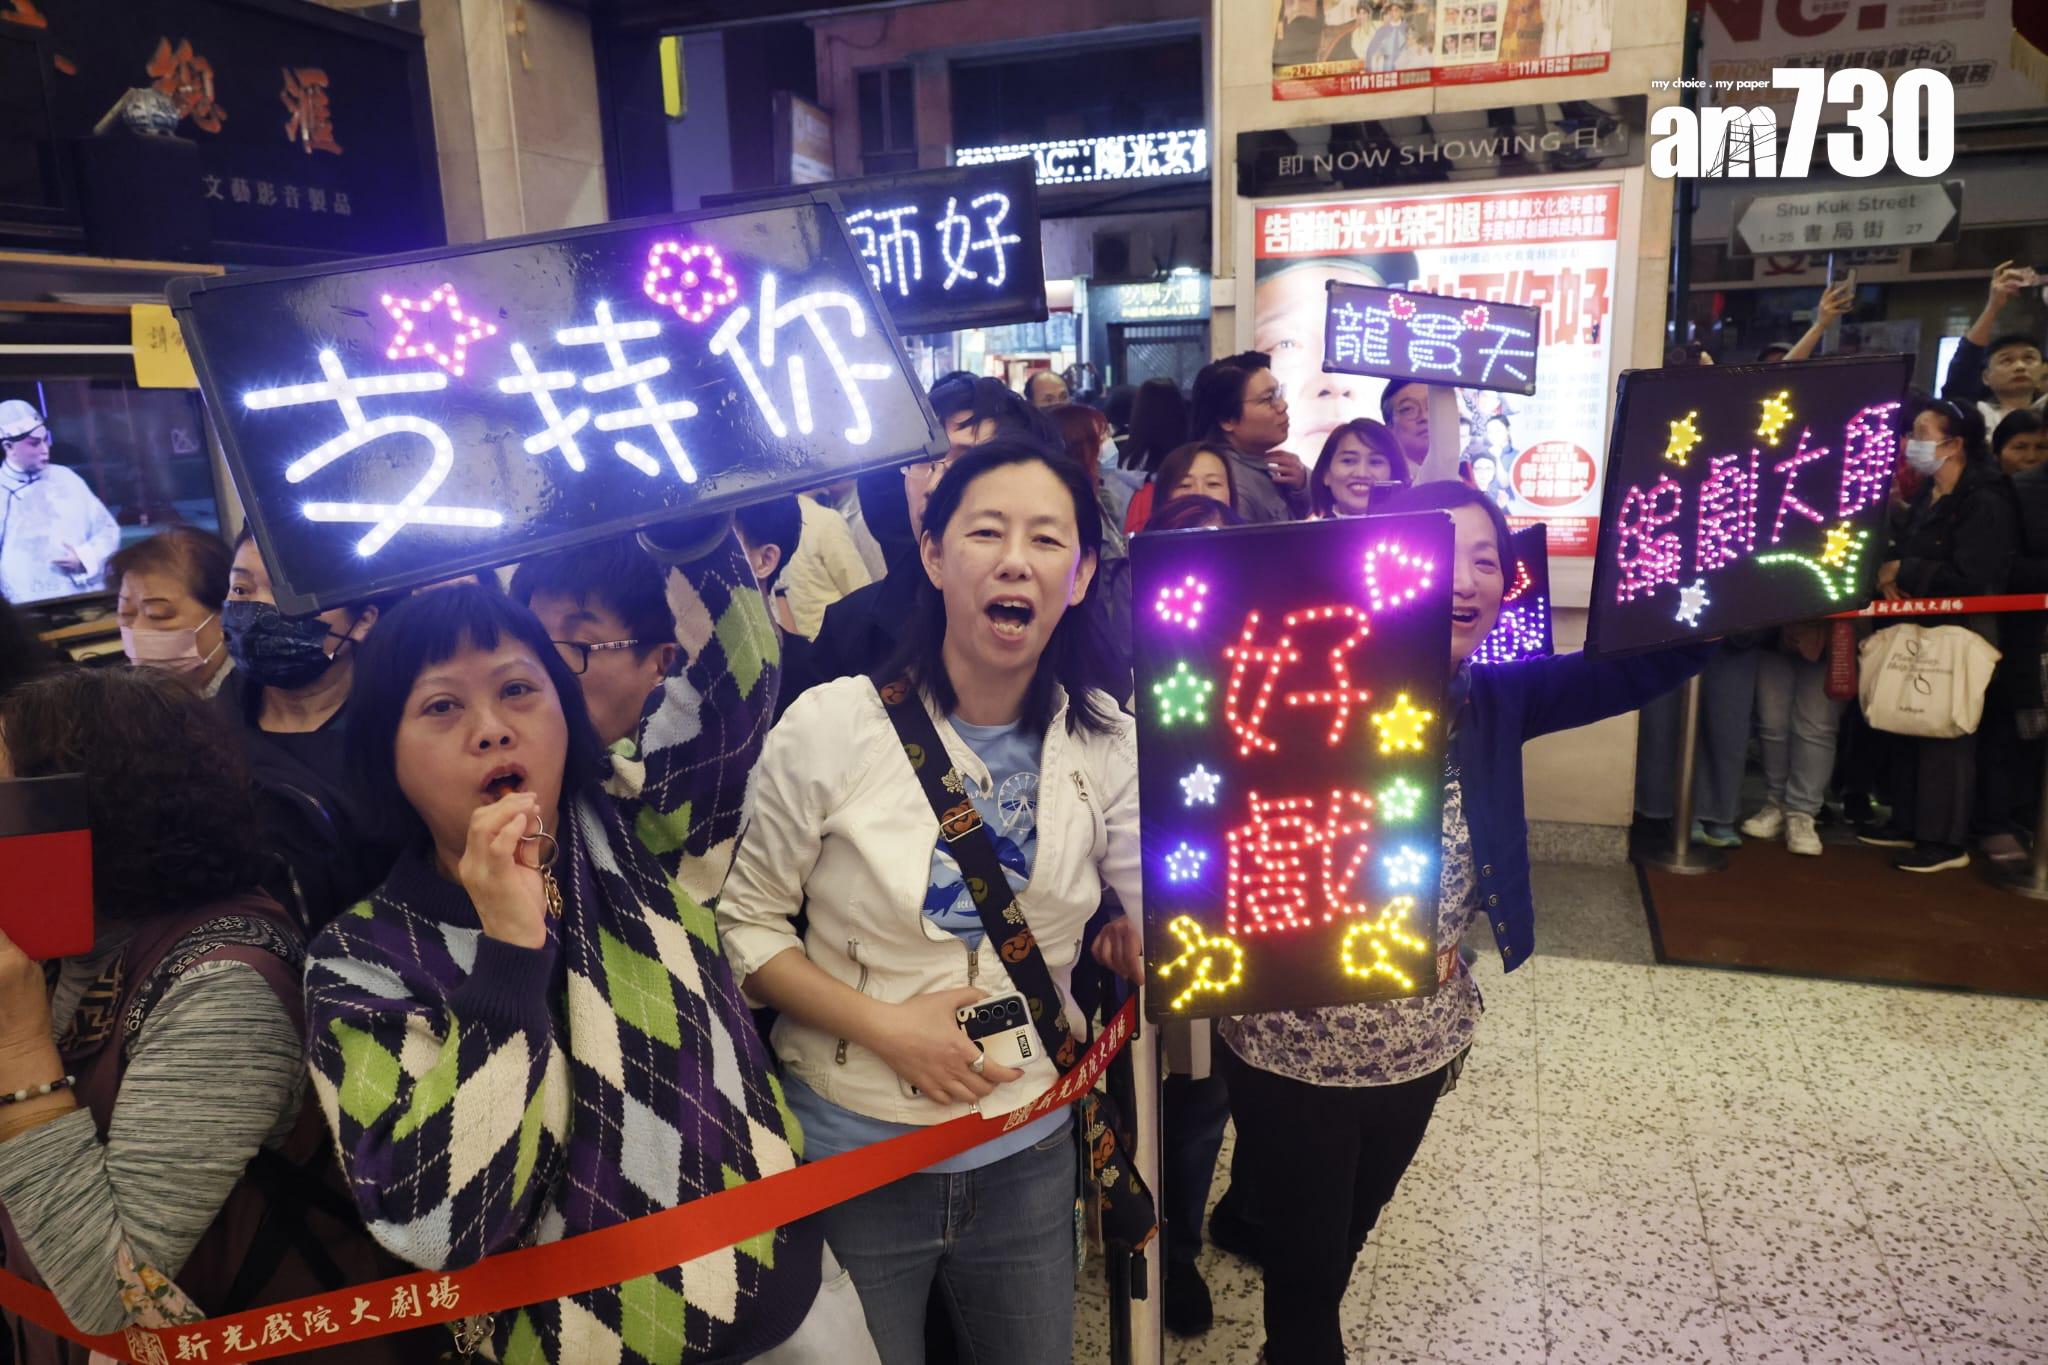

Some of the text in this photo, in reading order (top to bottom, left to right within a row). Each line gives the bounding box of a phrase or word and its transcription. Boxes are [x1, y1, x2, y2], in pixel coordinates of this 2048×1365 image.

[1278, 156, 1304, 176] 即
[1314, 149, 1391, 173] NOW
[1400, 132, 1561, 165] SHOWING
[1776, 194, 1917, 218] Shu Kuk Street
[1804, 220, 1884, 243] 書局街
[1905, 223, 1922, 235] 27
[243, 272, 893, 559] 支持你
[175, 1275, 461, 1362] 新光戲院大劇場
